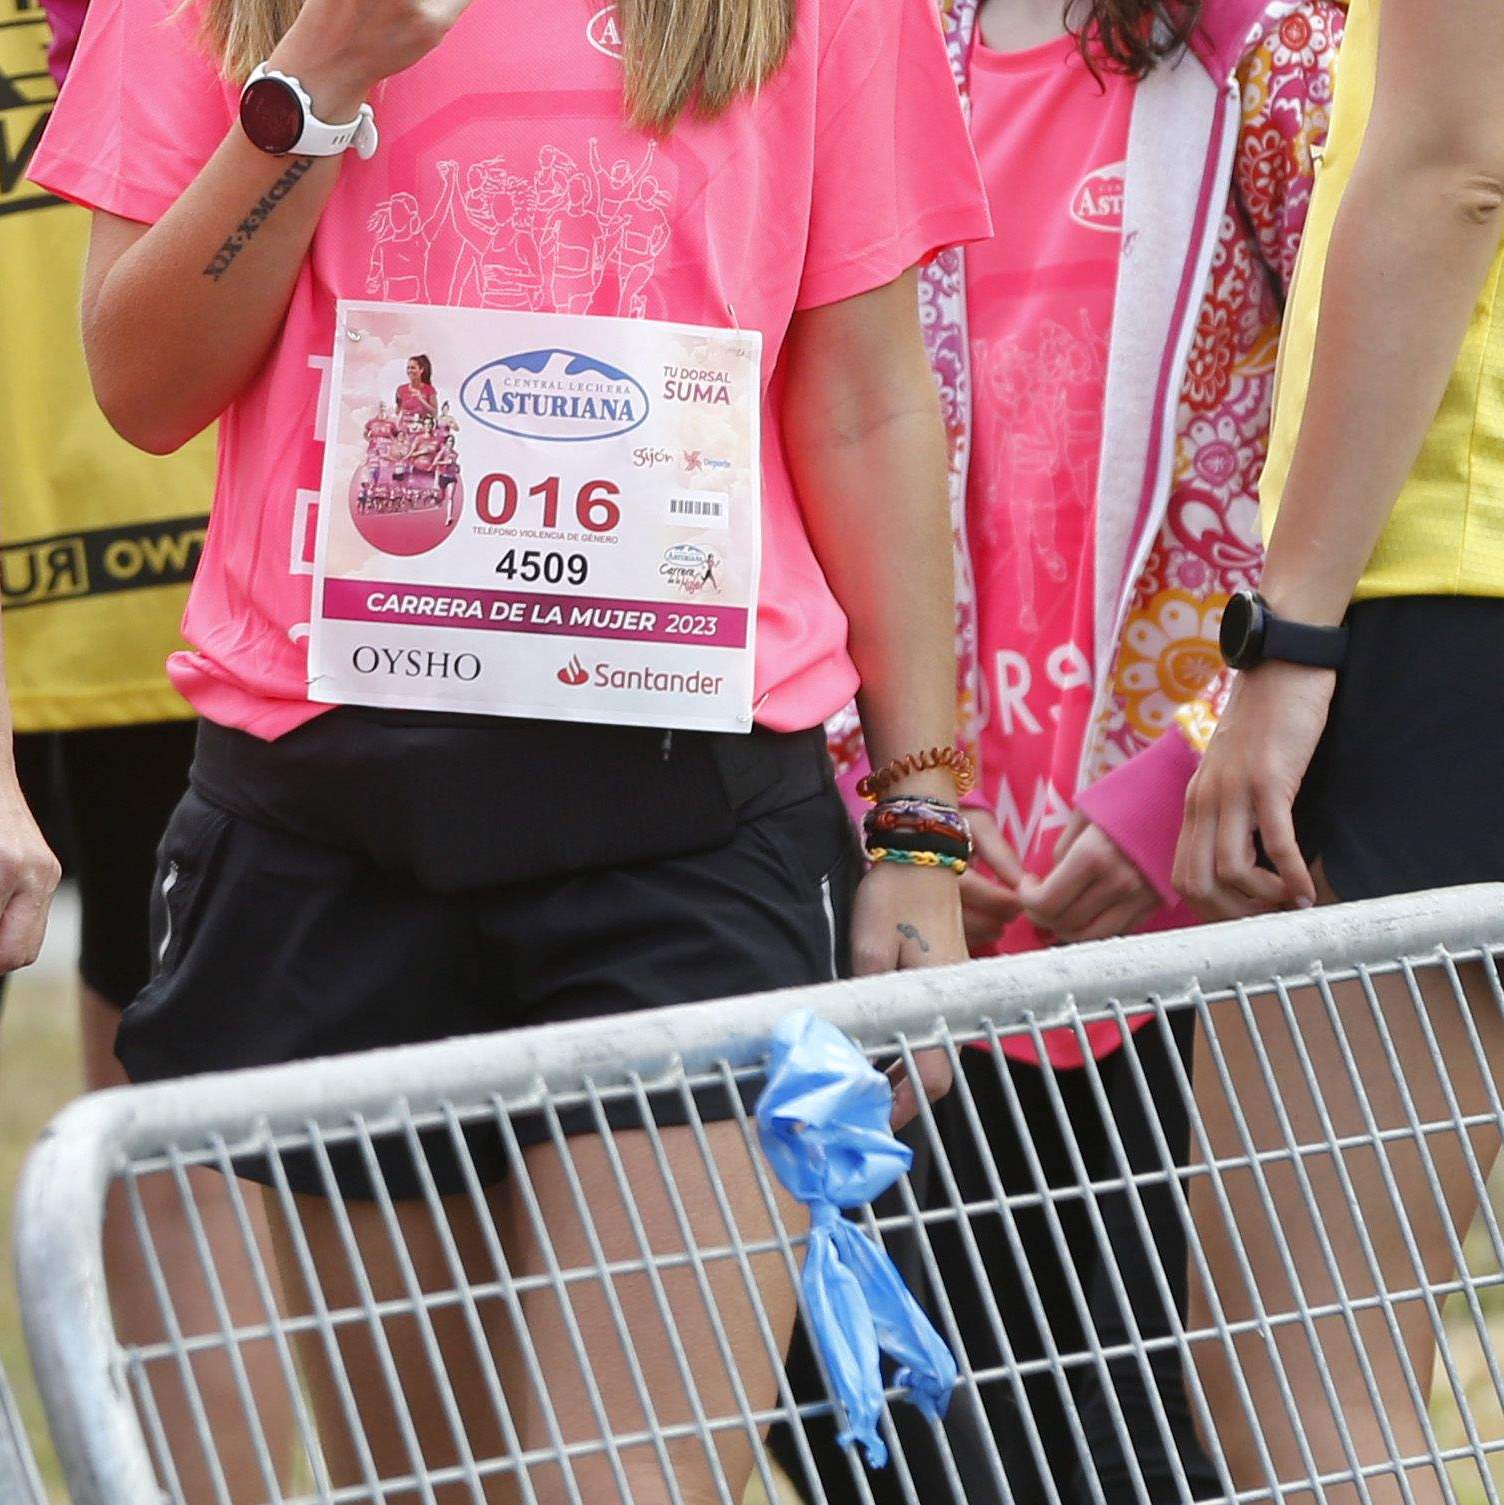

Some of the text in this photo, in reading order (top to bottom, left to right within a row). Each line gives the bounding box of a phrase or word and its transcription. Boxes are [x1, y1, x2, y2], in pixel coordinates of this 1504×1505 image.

[504, 377, 631, 394] CENTRAL LECHERA
[663, 365, 732, 384] TU DORSAL
[474, 378, 636, 422] ASTURIANA
[663, 380, 731, 406] SUMA
[475, 472, 621, 533] 016
[519, 529, 564, 541] VIOLENCIA
[567, 532, 579, 542] DE
[495, 549, 589, 586] 4509
[366, 592, 718, 636] CARRERA DE LA MUJER 2023
[352, 645, 482, 681] OYSHO
[594, 664, 724, 695] Santander
